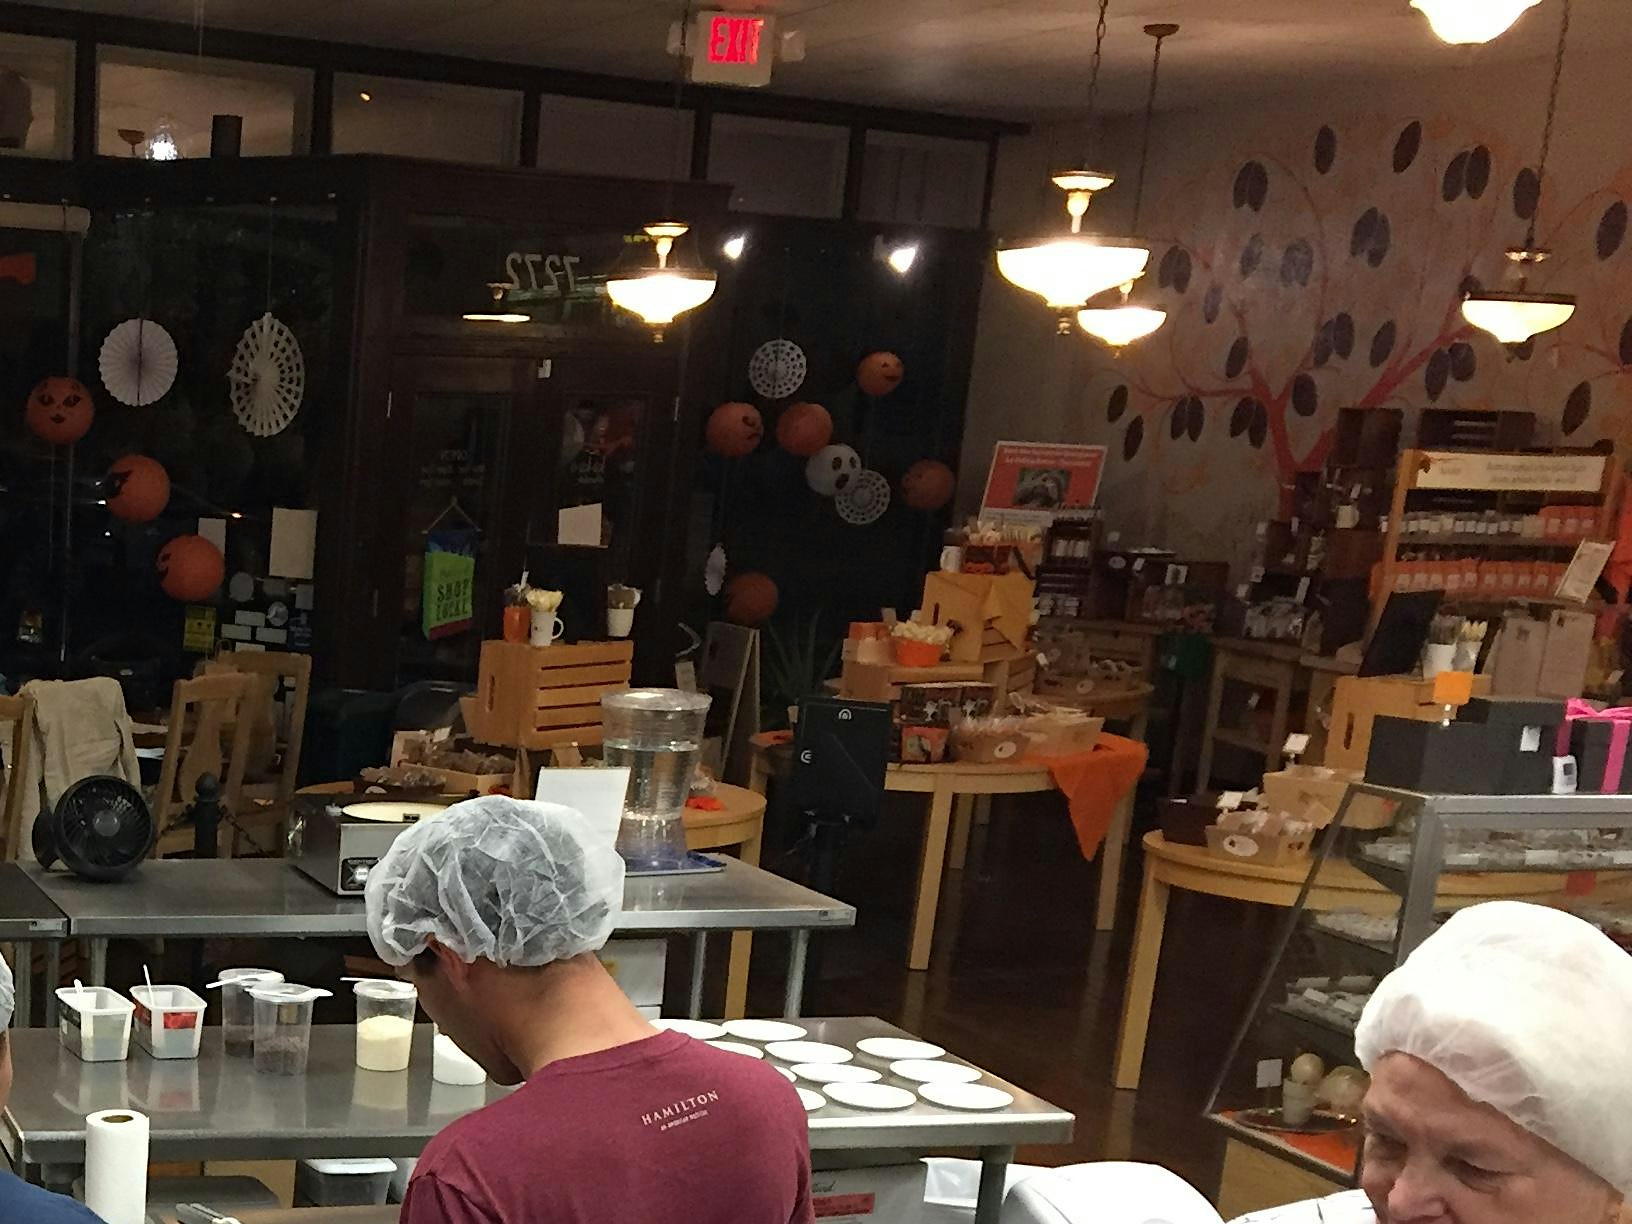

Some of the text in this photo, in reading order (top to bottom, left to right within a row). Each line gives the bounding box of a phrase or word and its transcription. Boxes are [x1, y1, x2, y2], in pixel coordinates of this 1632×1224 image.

[708, 16, 764, 64] EXIT
[436, 579, 470, 603] SHOP
[436, 599, 469, 621] LOCAL
[641, 1090, 719, 1125] HAMILTON
